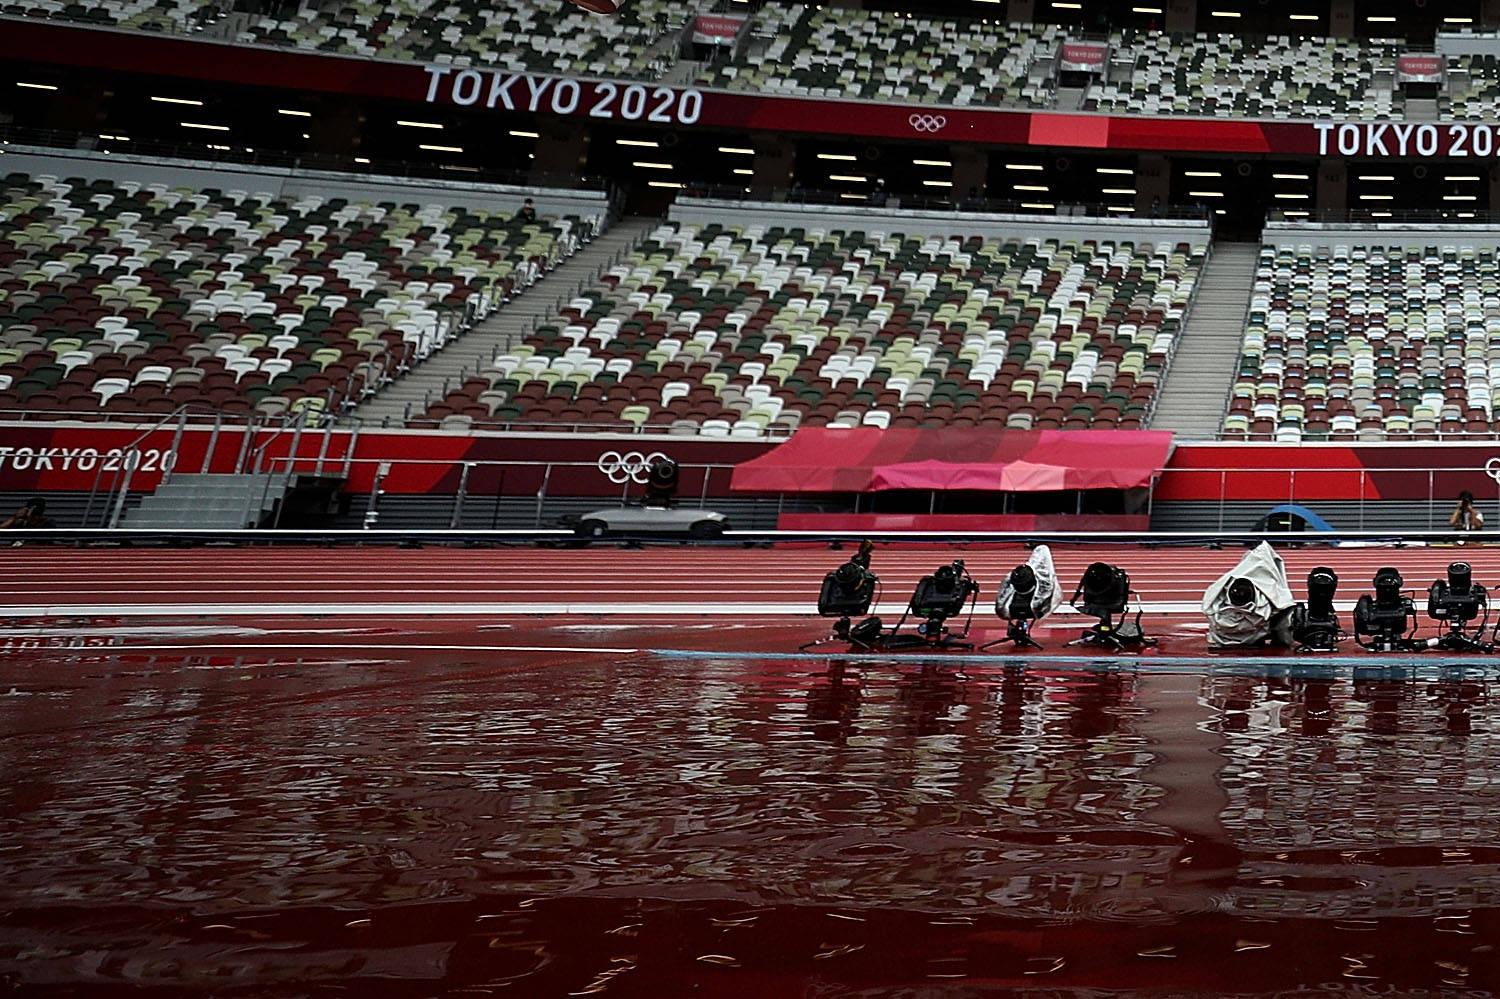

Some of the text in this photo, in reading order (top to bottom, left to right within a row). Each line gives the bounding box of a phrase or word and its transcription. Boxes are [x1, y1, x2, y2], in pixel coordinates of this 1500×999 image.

[424, 65, 703, 124] TOKYO 2020
[1313, 124, 1438, 156] TOKYO
[0, 447, 178, 472] TOKYO 2020
